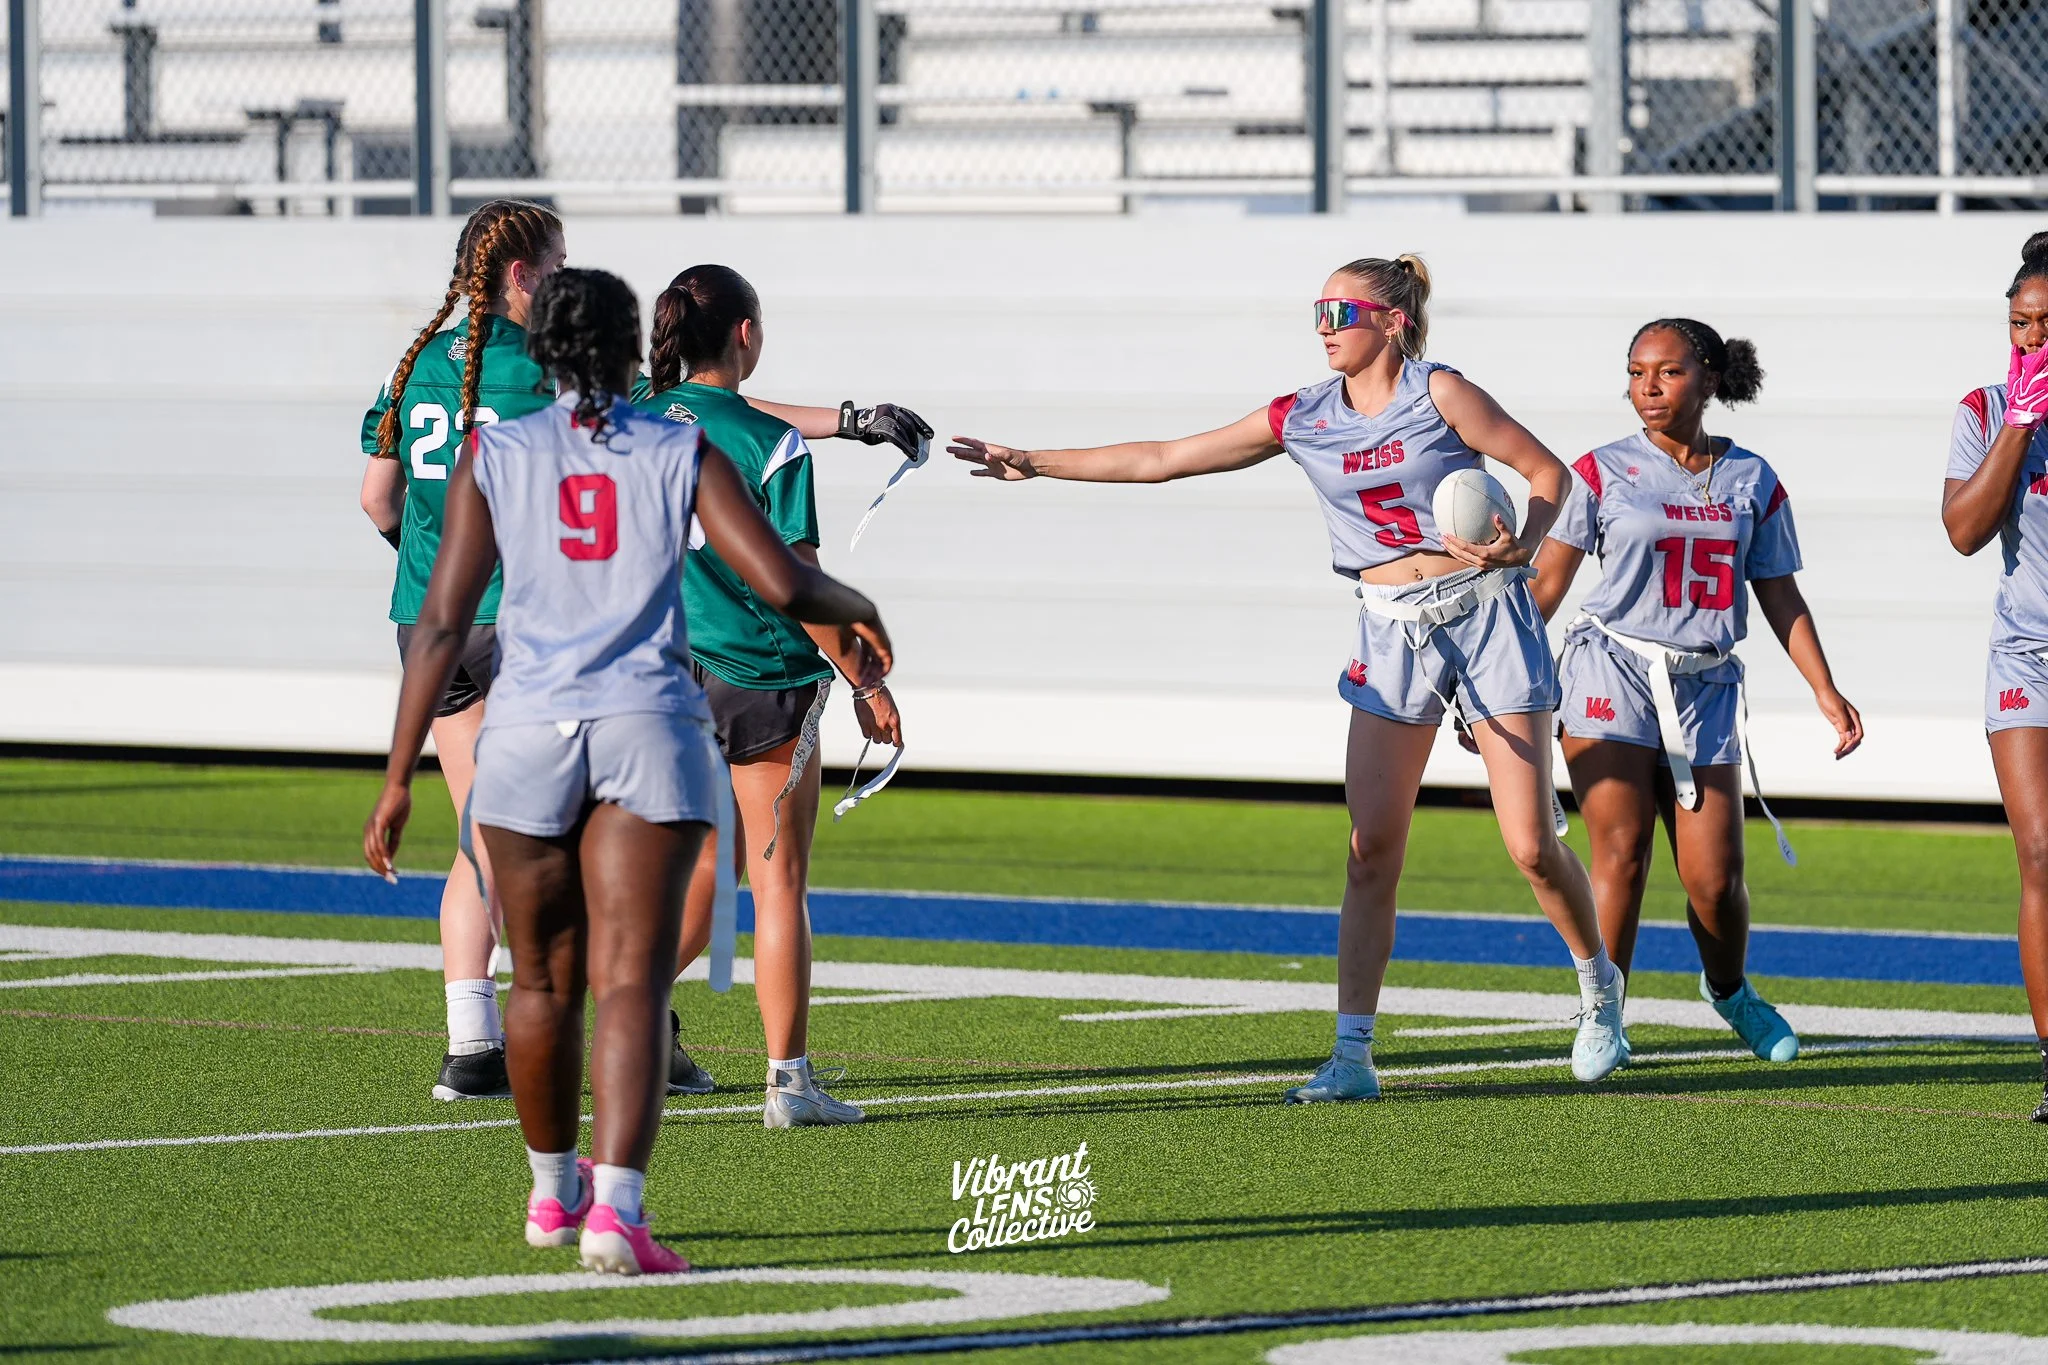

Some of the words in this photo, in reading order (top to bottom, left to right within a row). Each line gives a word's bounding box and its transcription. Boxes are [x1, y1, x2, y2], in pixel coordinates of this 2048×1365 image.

[1342, 439, 1405, 475] WEISS
[559, 474, 618, 561] 9
[1356, 482, 1425, 548] 5
[1661, 502, 1733, 522] WEISS
[1655, 536, 1739, 611] 15
